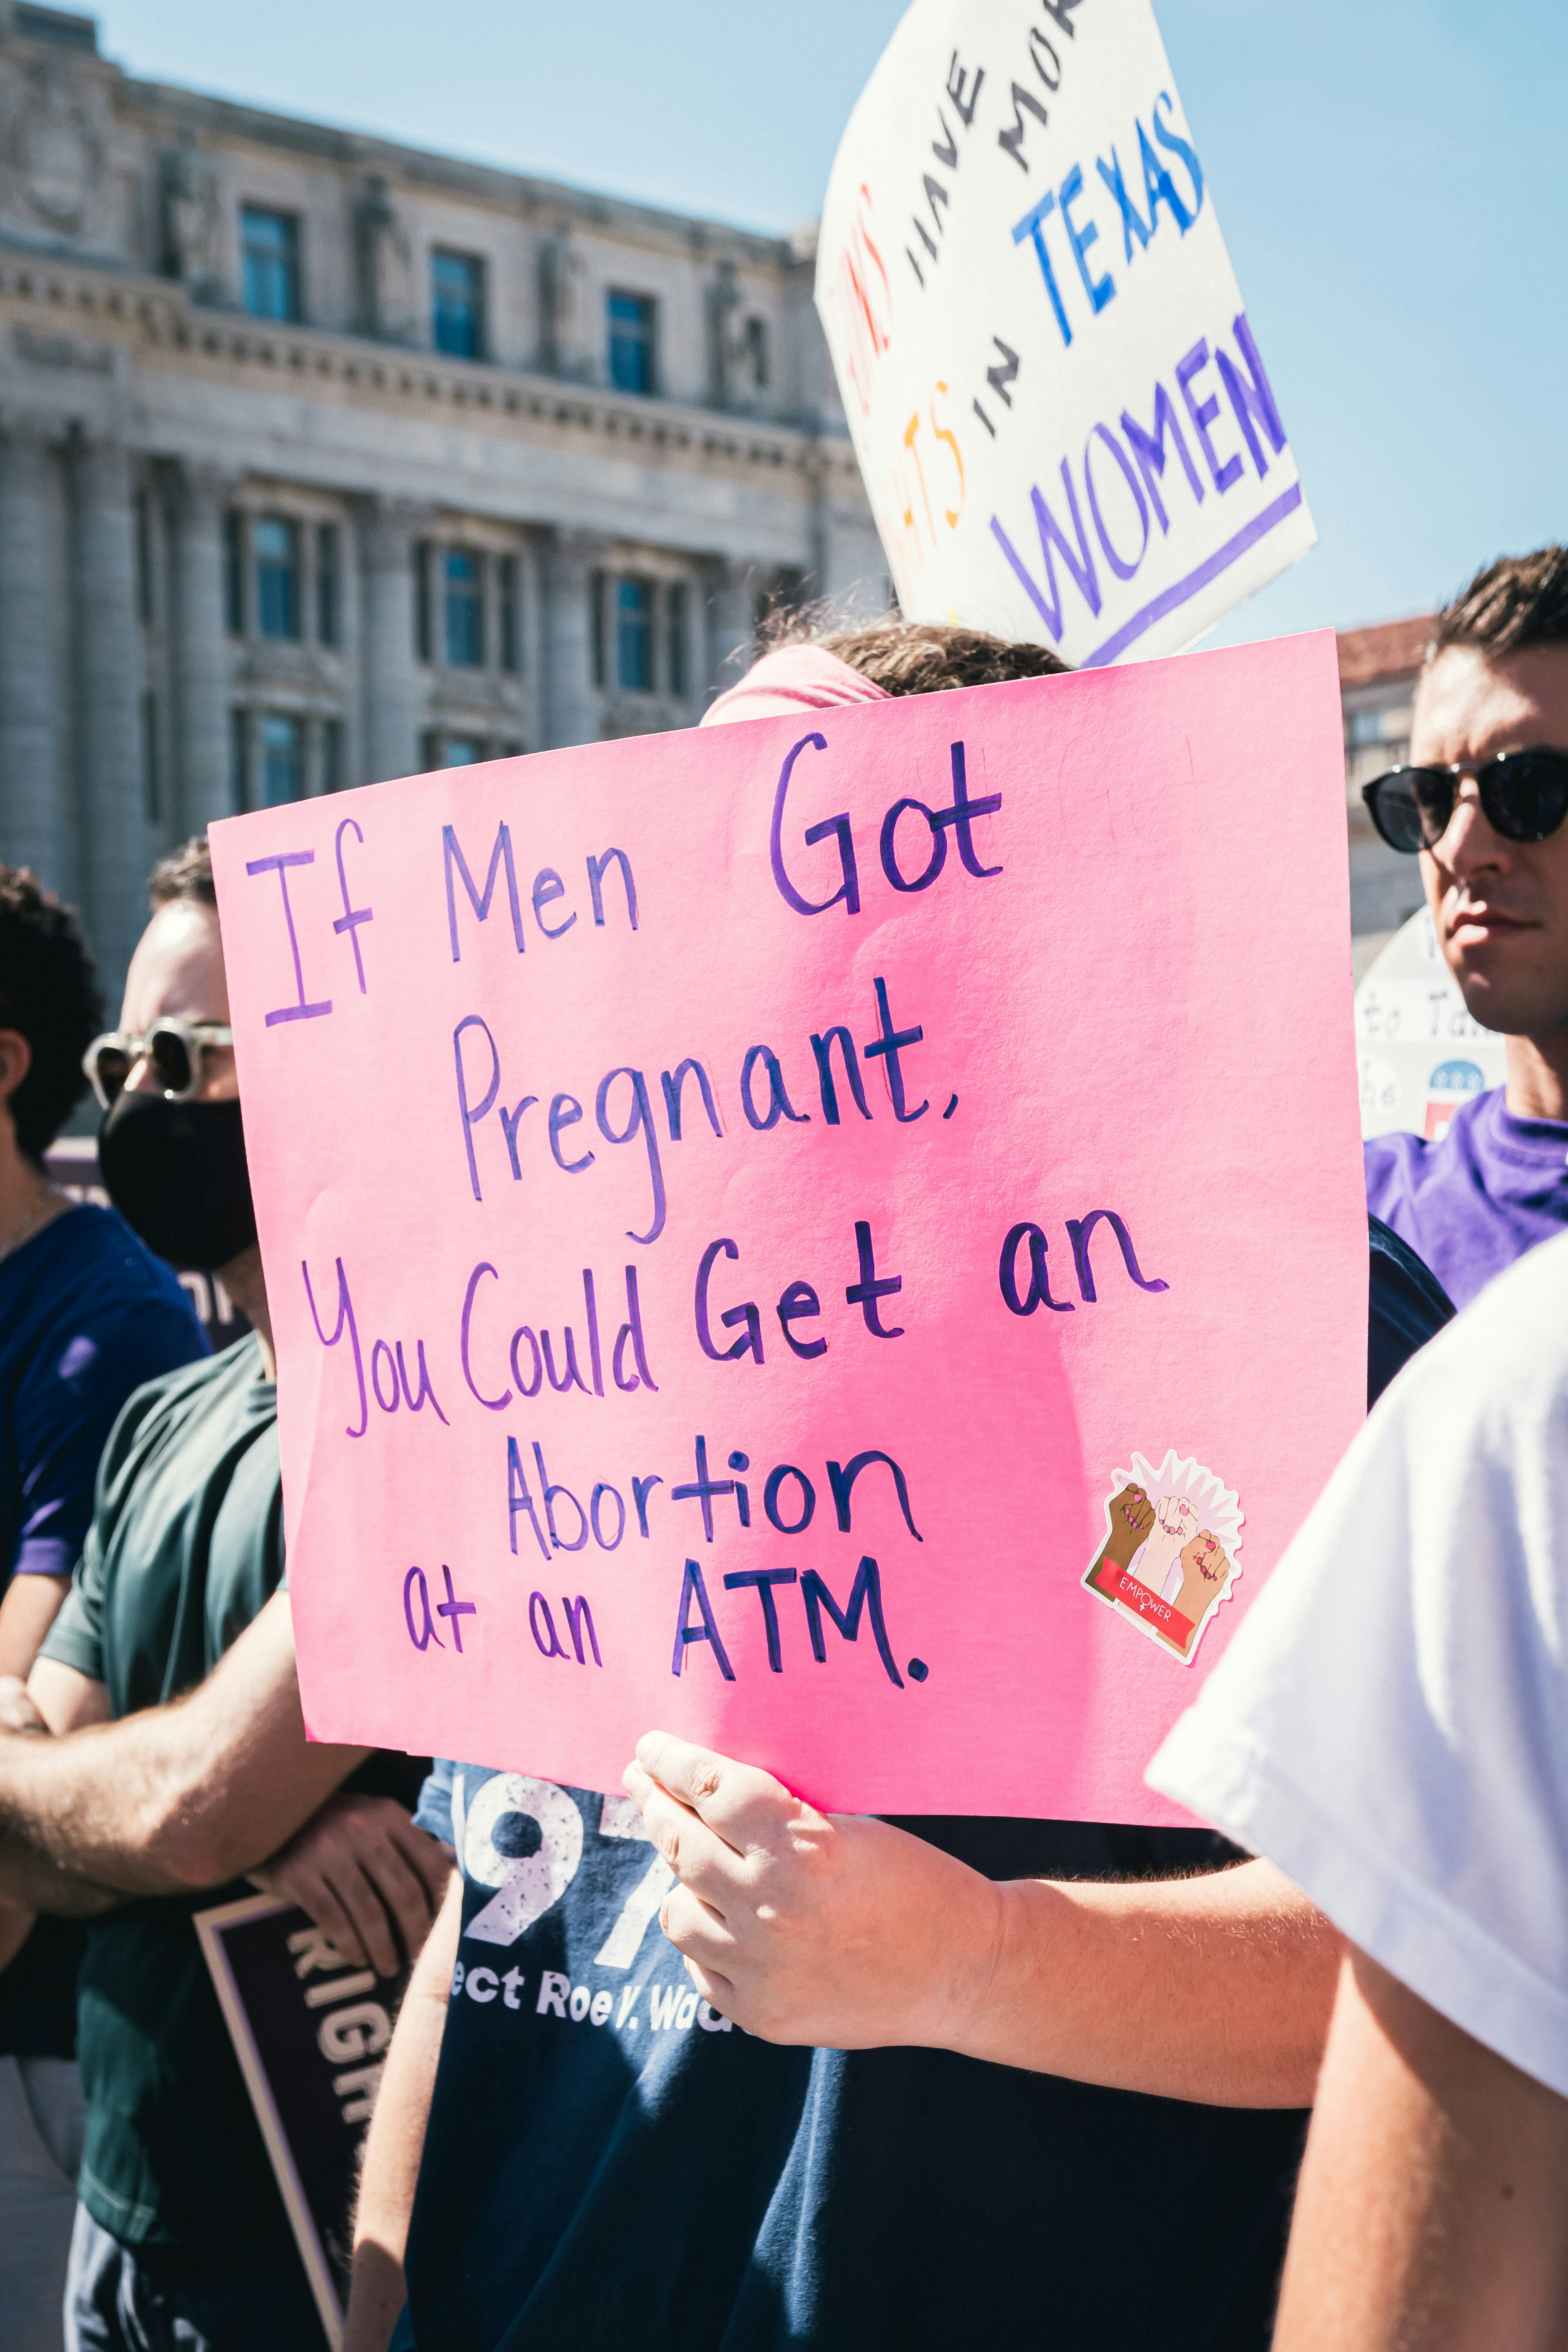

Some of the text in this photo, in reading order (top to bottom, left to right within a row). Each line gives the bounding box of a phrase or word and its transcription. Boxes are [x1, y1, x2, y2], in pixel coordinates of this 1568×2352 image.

[906, 48, 985, 291] HAVE
[998, 0, 1083, 175] MOR
[972, 334, 1020, 438] IN
[1011, 89, 1204, 348] TEXAS
[989, 311, 1287, 645] WOMEN
[247, 732, 1004, 1028] If Men Got
[453, 976, 958, 1246] Pregnant,
[302, 1210, 1170, 1438] You Could Get an
[507, 1435, 923, 1561] Abortion
[1119, 1577, 1171, 1622] EMPOWER
[403, 1555, 930, 1690] at an ATM.
[286, 1926, 391, 2127] RIGH
[535, 1971, 614, 2027] Roe
